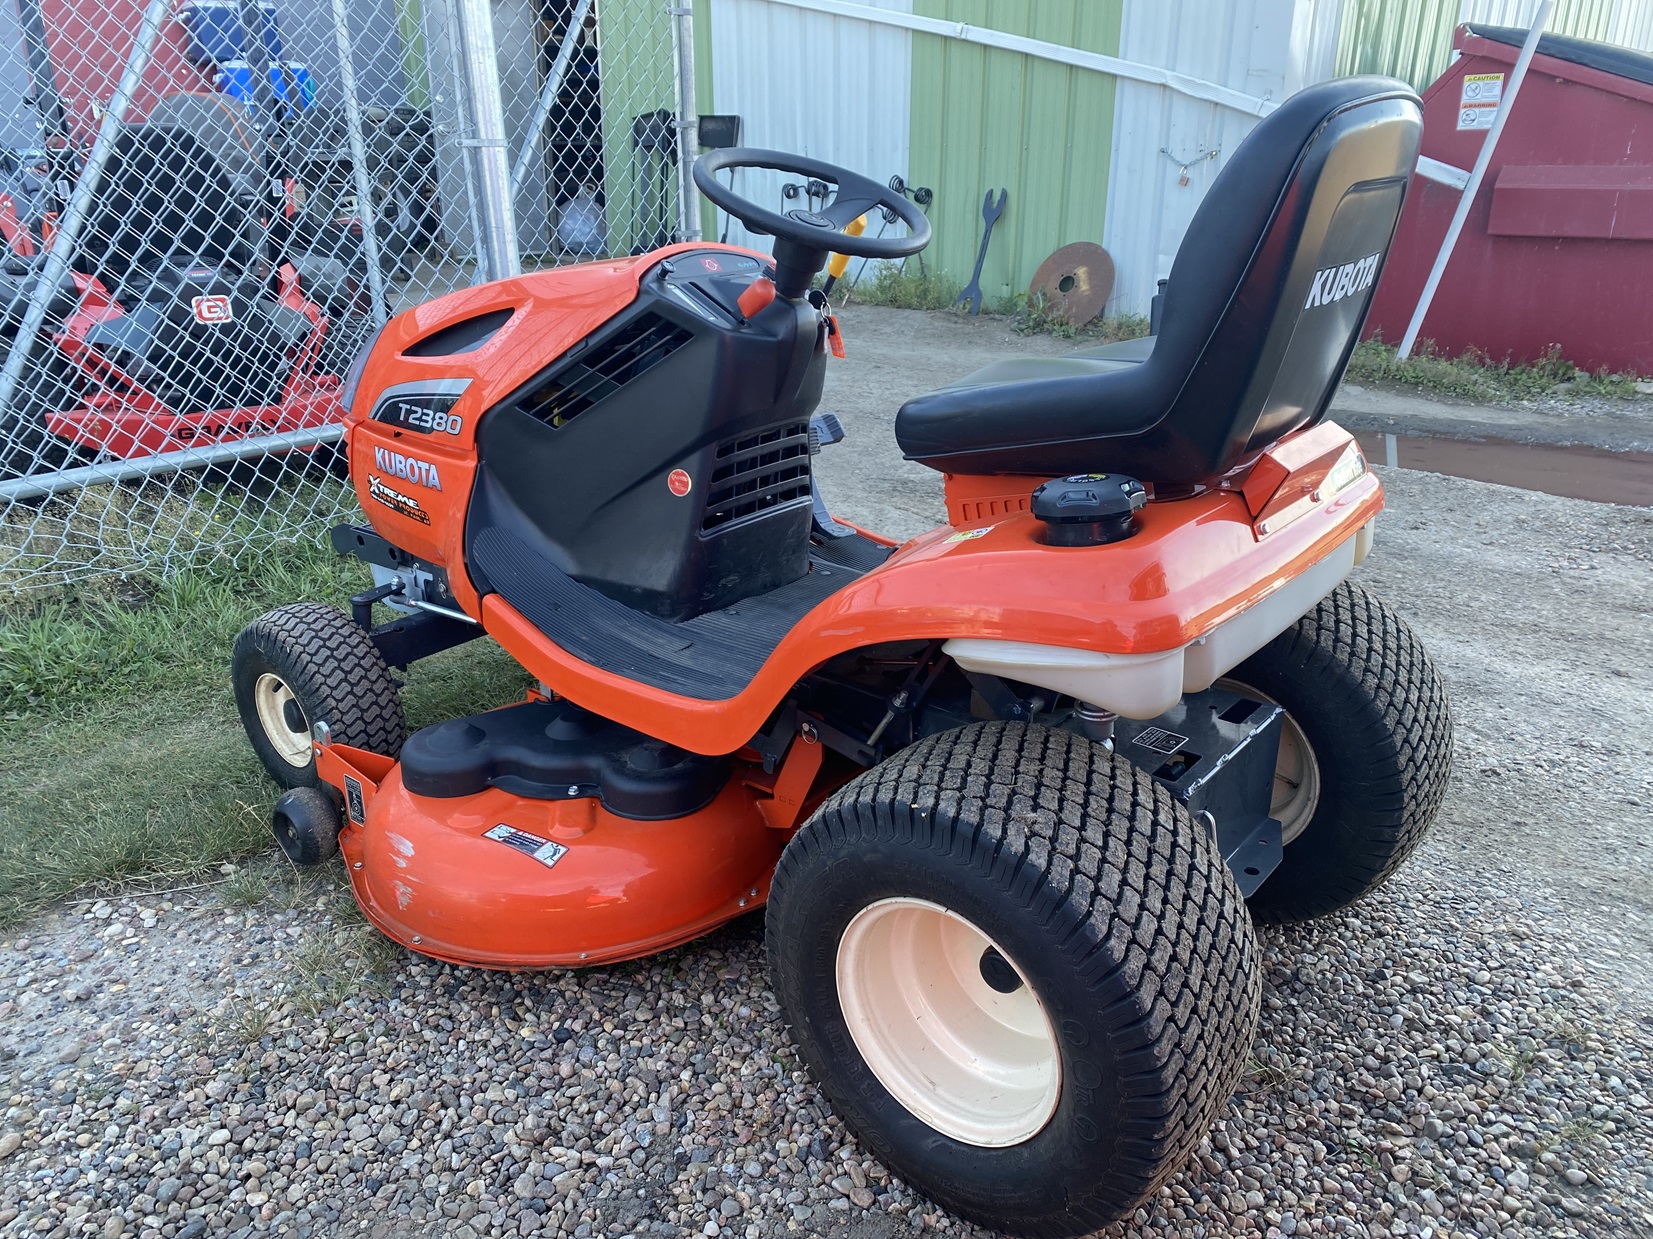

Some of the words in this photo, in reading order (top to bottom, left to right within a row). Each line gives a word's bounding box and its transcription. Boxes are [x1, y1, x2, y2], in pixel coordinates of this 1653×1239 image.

[1304, 253, 1380, 309] KUBOTA
[177, 418, 281, 440] GRAVELY
[398, 402, 463, 436] T2380
[374, 445, 443, 492] KUBOTA
[368, 474, 420, 510] XTREME
[379, 493, 398, 505] POWER
[399, 503, 429, 519] PRODUCTS
[522, 832, 548, 843] DANGER
[859, 1081, 886, 1112] FOR
